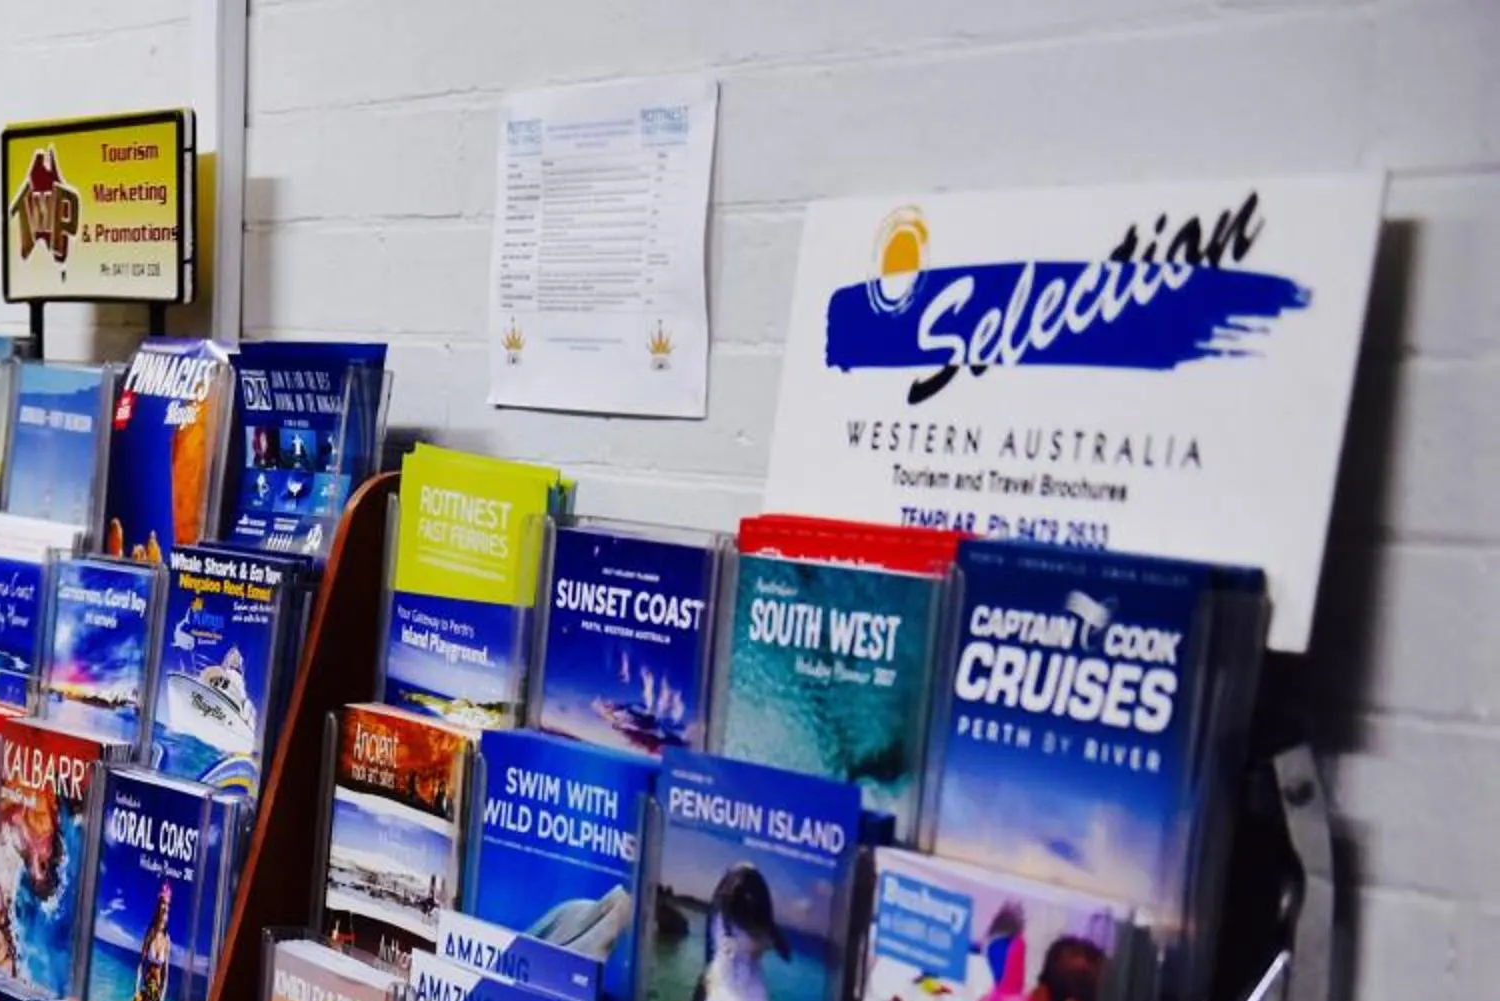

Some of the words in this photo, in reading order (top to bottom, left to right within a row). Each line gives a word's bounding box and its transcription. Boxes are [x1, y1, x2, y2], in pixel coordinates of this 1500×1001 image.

[101, 142, 159, 163] Tourism
[93, 183, 168, 205] Marketing
[81, 226, 92, 243] &
[95, 223, 178, 243] Promotions
[908, 192, 1264, 405] Selection
[126, 352, 219, 401] PINNACLES
[846, 419, 981, 455] WESTERN
[998, 433, 1204, 469] AUSTRALIA
[420, 484, 513, 534] ROTTNEST
[893, 464, 950, 491] Tourism
[954, 470, 984, 493] and
[987, 470, 1037, 495] Travel
[1040, 474, 1129, 502] Brochures
[418, 517, 449, 543] FAST
[450, 524, 510, 560] FERRIES
[204, 557, 237, 578] Shark
[555, 577, 633, 619] SUNSET
[633, 590, 706, 631] COAST
[749, 597, 823, 650] SOUTH
[829, 607, 902, 662] WEST
[970, 604, 1077, 648] CAPTAIN
[1104, 623, 1182, 664] COOK
[955, 641, 1178, 733] CRUISES
[353, 722, 400, 768] Ancient
[957, 714, 1032, 748] PERTH
[1084, 738, 1161, 773] RIVER
[3, 740, 92, 802] KALBARR
[505, 766, 561, 805] SWIM
[566, 778, 619, 820] WITH
[484, 796, 533, 835] WILD
[537, 808, 641, 863] DOLPHINS
[669, 786, 764, 834] PENGUIN
[767, 808, 845, 855] ISLAND
[445, 930, 530, 984] AMAZING
